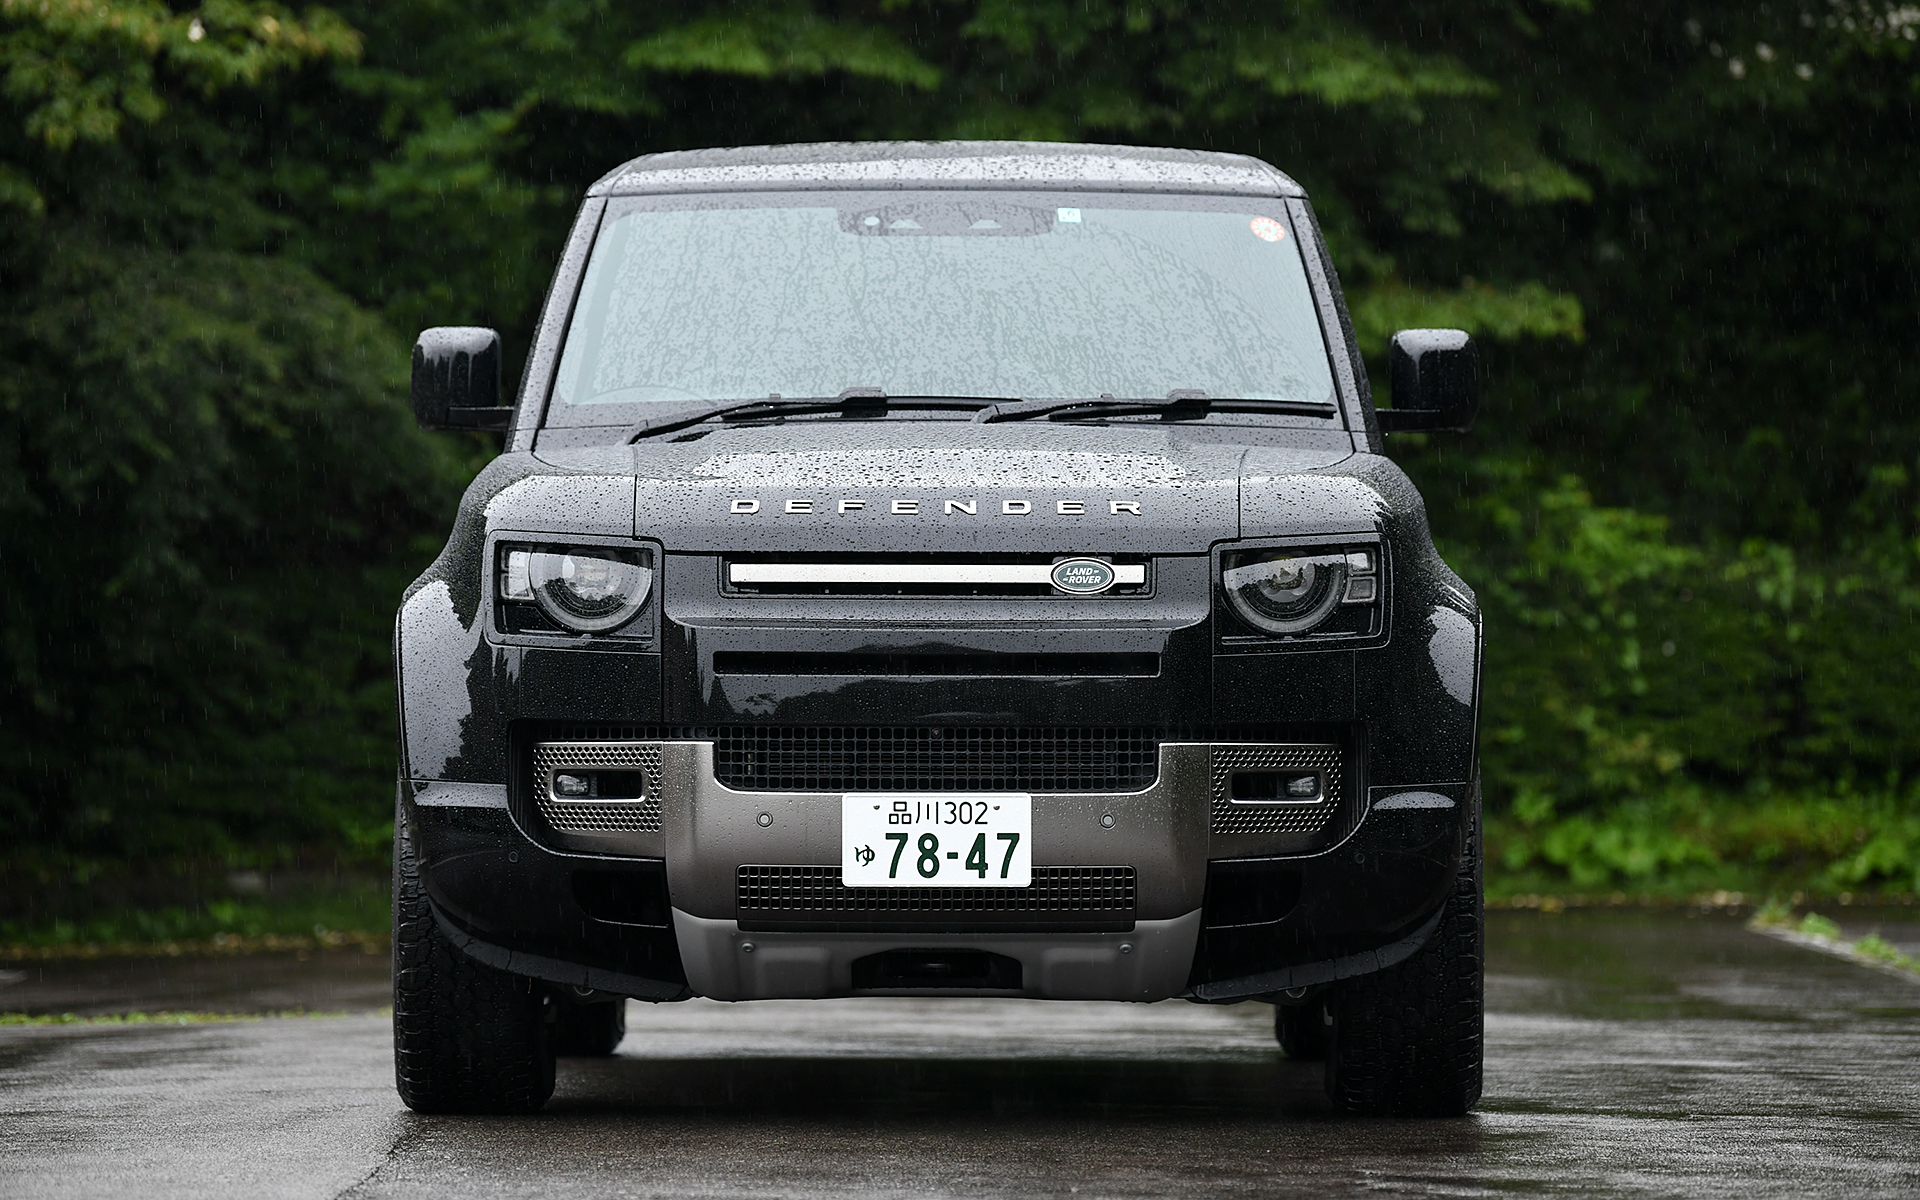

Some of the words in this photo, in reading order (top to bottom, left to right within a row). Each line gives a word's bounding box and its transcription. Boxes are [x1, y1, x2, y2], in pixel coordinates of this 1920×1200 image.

[730, 499, 1142, 515] DEFENDER
[854, 844, 875, 867] ゆ
[885, 832, 1020, 879] 78-47
